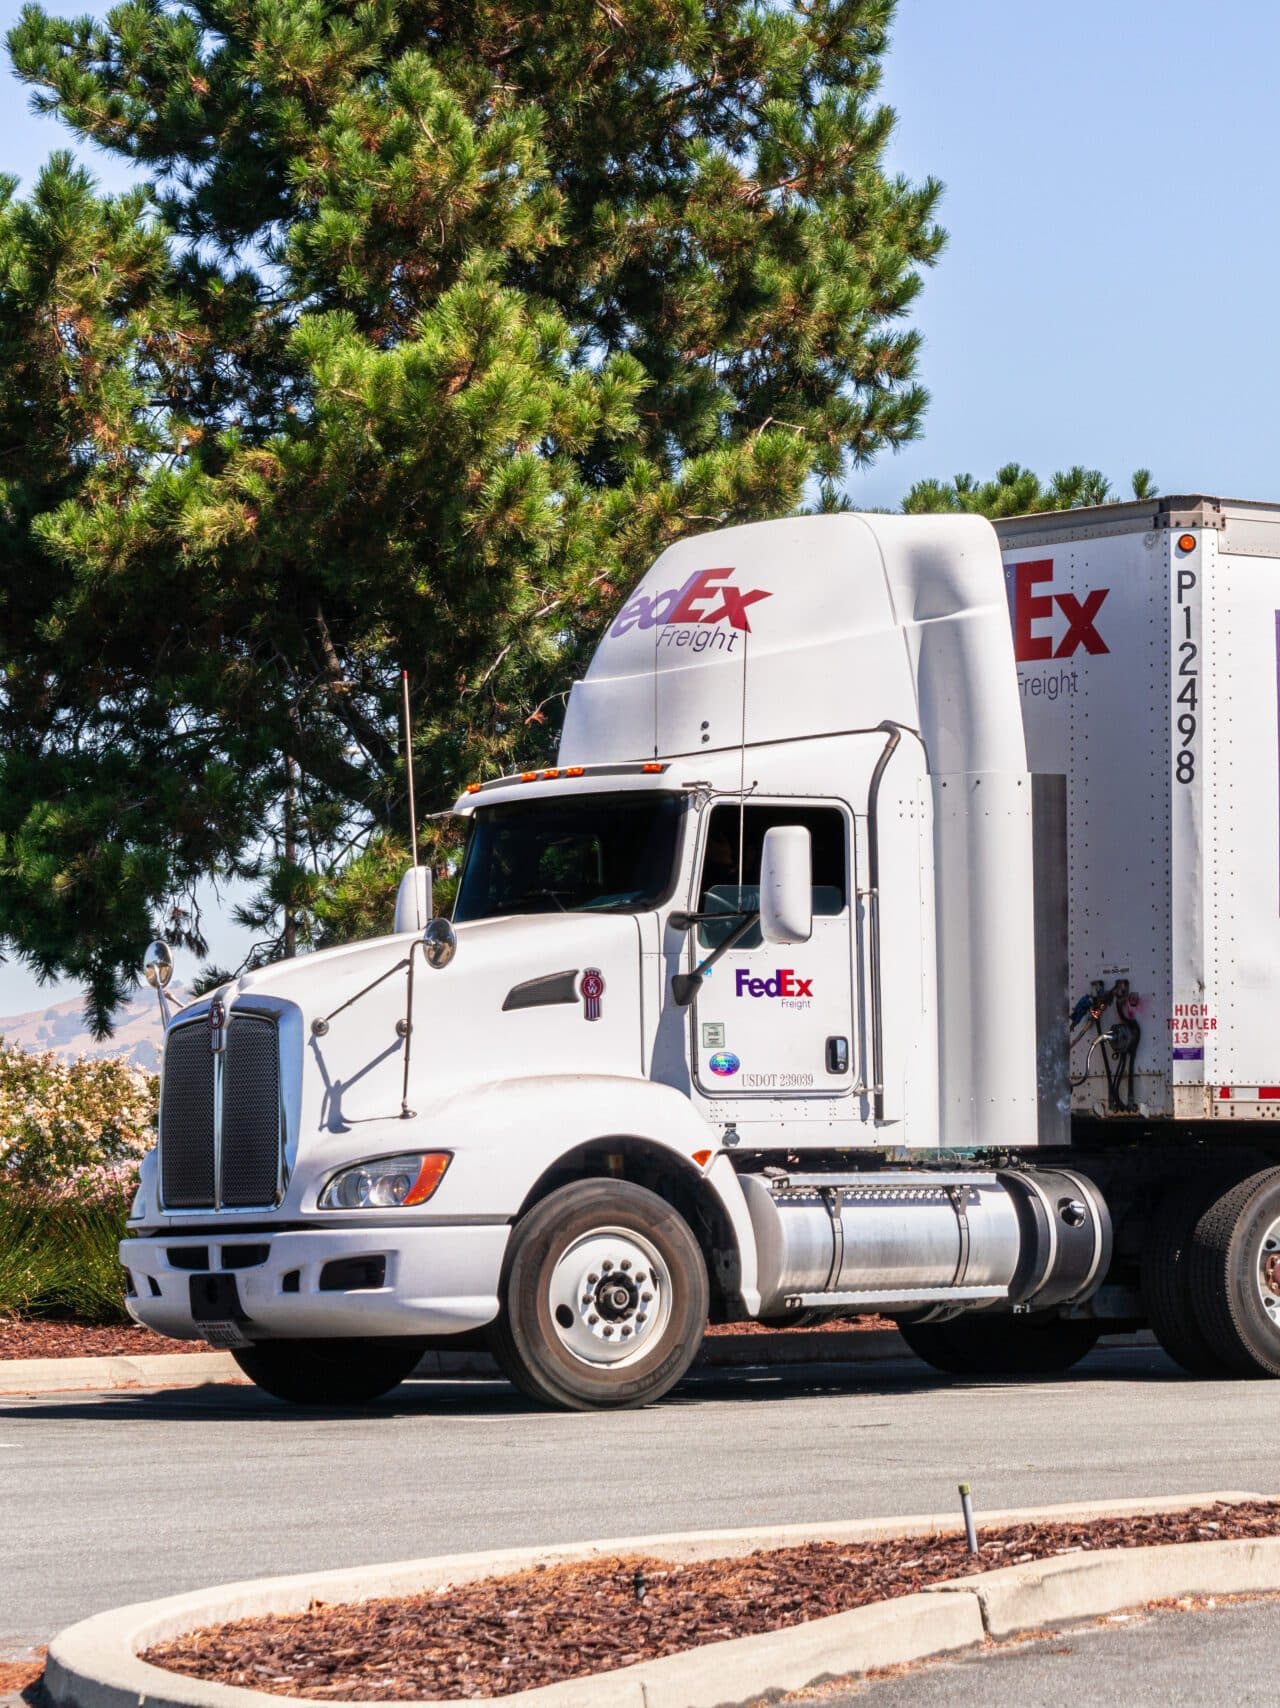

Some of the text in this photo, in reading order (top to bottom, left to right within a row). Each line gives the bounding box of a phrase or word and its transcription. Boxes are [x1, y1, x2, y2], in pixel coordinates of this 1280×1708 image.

[610, 567, 773, 638] edEx
[656, 624, 738, 652] Freight
[1176, 570, 1198, 784] P12498
[735, 968, 814, 998] FedEx
[781, 999, 811, 1011] Freight
[1174, 1004, 1208, 1017] HIGH
[1167, 1018, 1217, 1030] TRAILER
[741, 1073, 814, 1087] USDOT 239039
